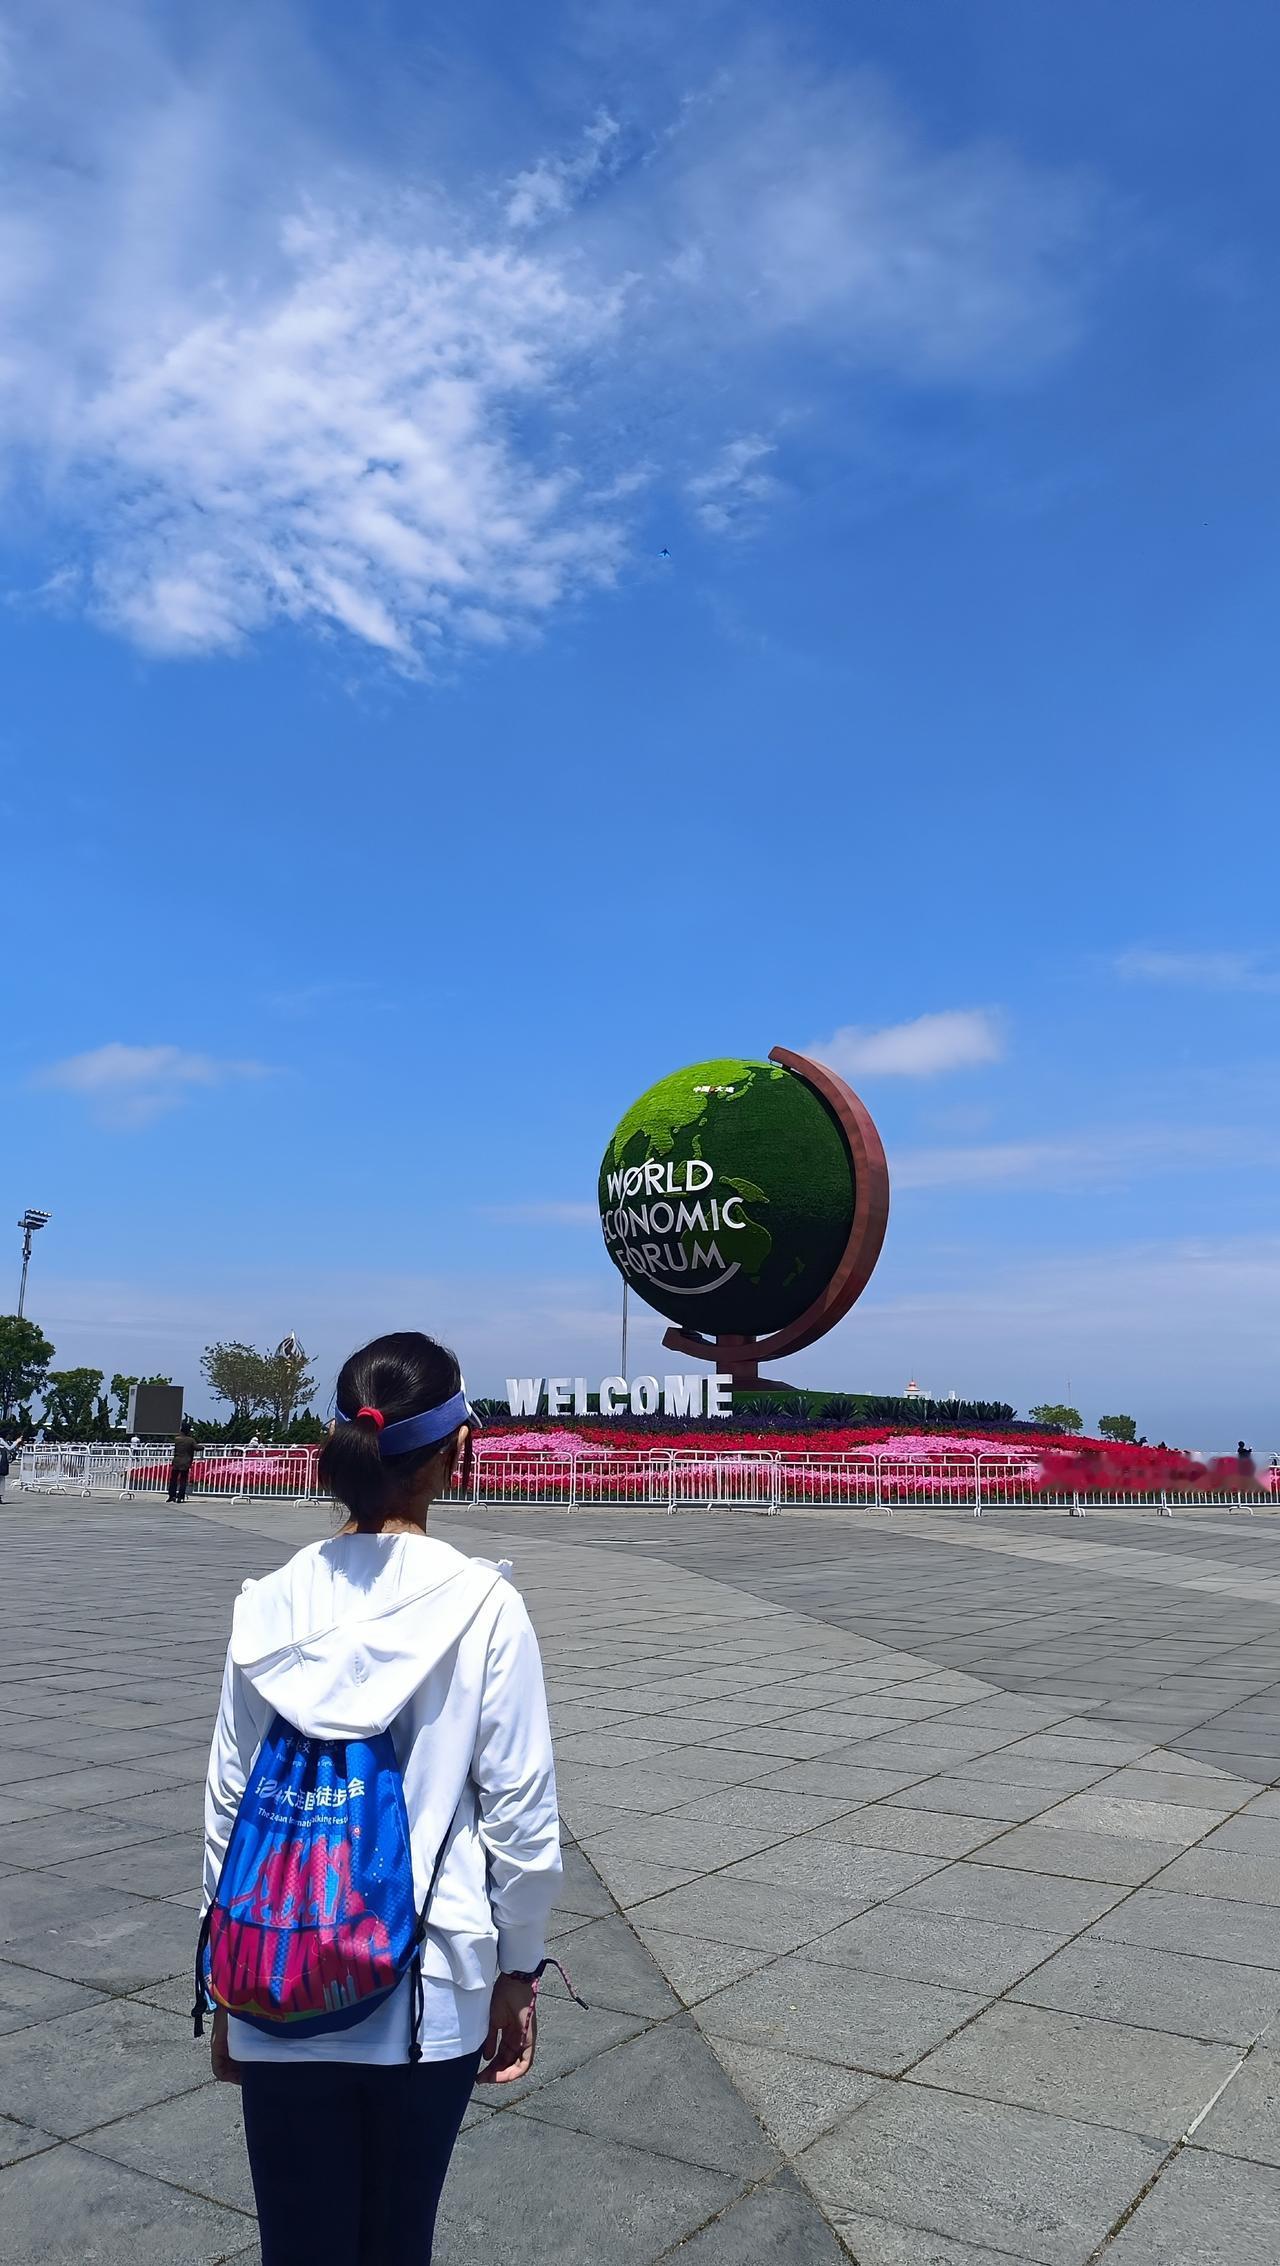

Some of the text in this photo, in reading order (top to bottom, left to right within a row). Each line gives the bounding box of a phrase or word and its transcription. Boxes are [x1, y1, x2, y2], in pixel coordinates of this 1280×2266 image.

[607, 1159, 714, 1202] WORLD
[602, 1197, 746, 1243] ECONOMIC
[616, 1240, 726, 1278] FORUM
[506, 1374, 733, 1419] WELCOME
